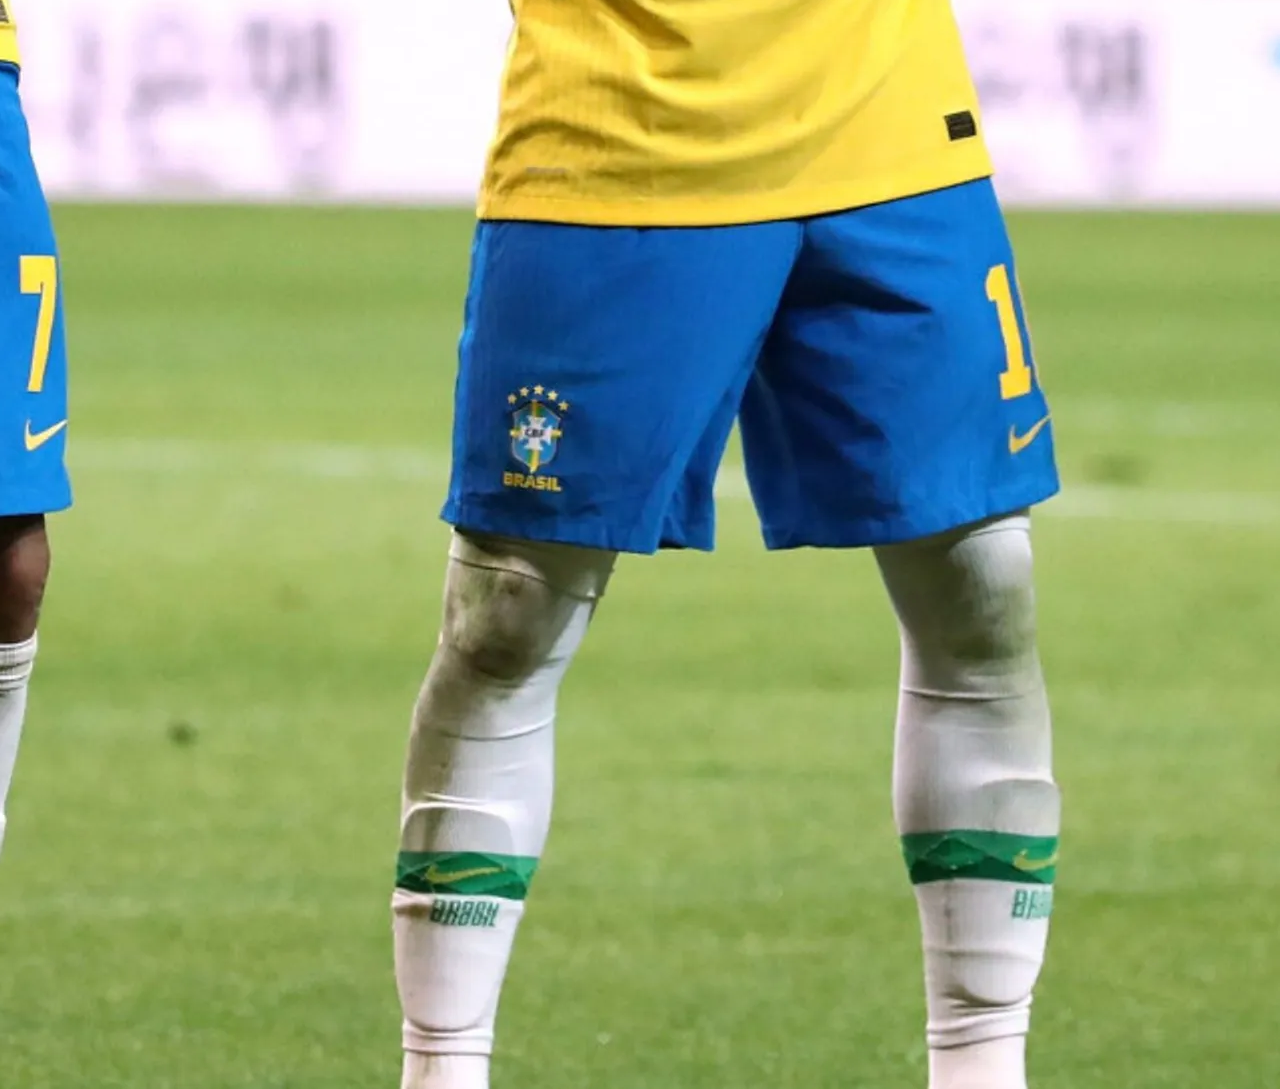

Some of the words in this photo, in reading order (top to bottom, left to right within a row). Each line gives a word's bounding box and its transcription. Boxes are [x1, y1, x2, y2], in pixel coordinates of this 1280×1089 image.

[19, 254, 57, 393] 7
[985, 263, 1031, 400] 1
[503, 472, 562, 491] BRASIL
